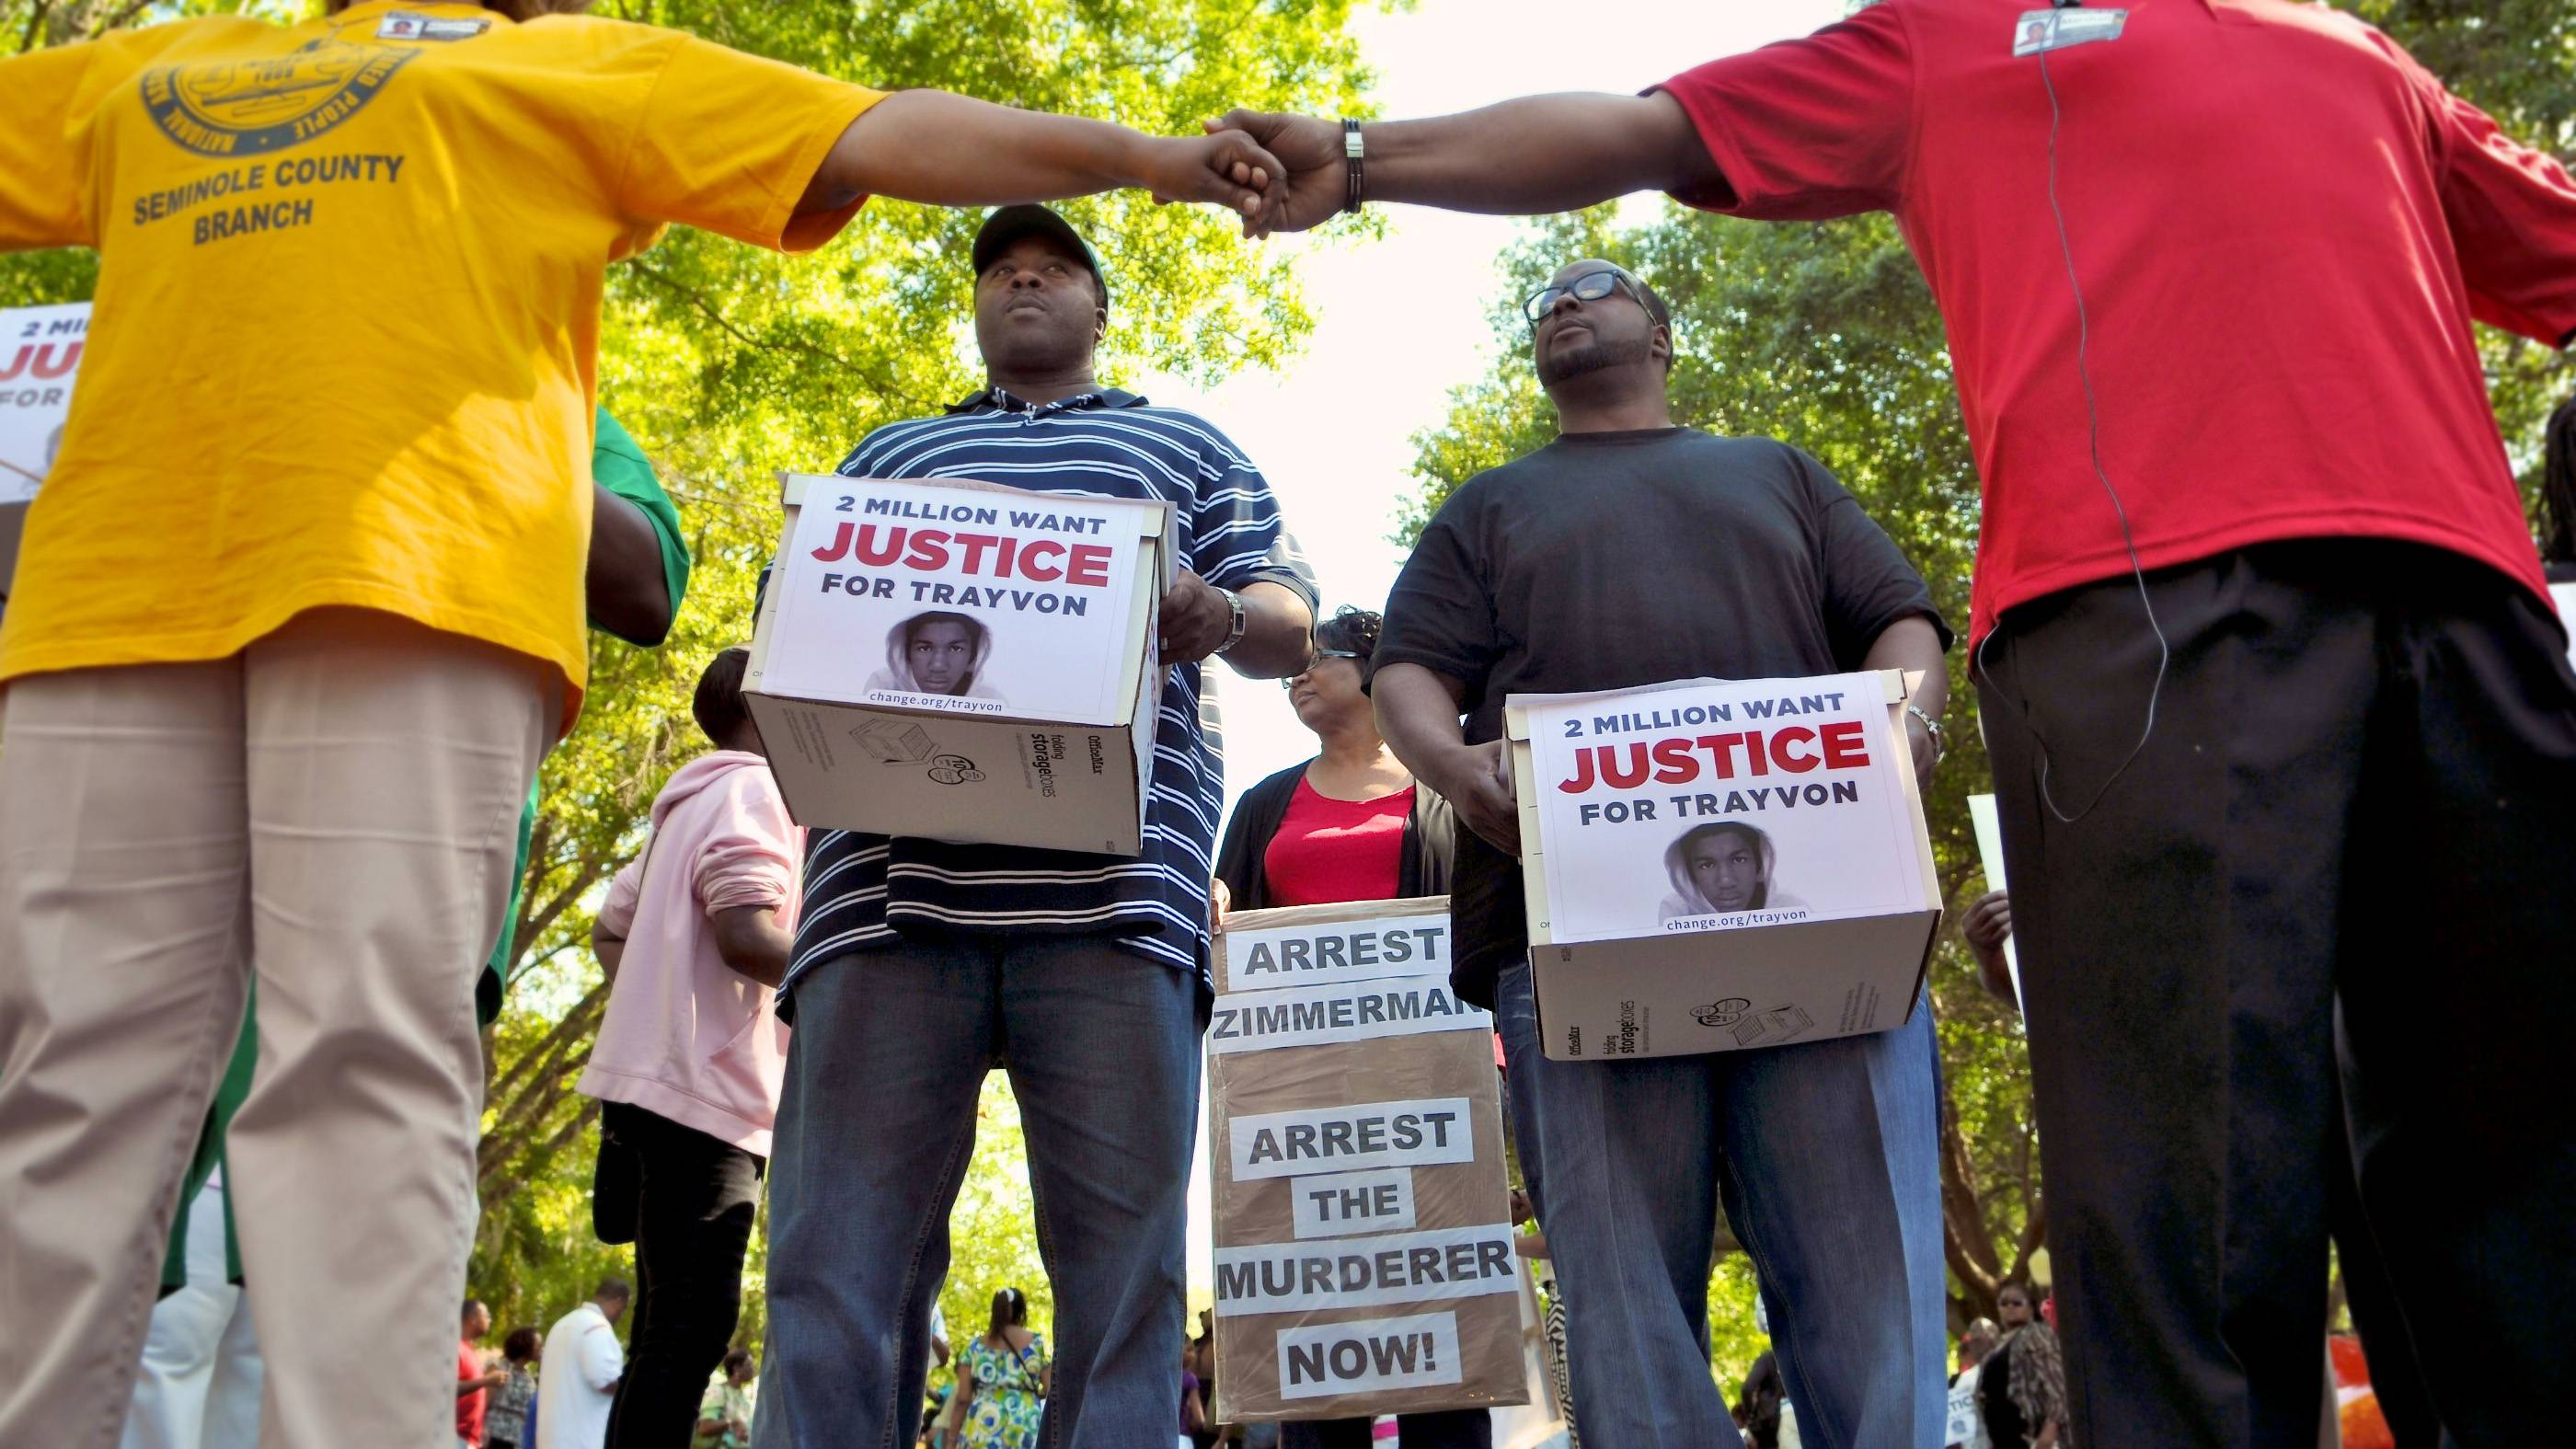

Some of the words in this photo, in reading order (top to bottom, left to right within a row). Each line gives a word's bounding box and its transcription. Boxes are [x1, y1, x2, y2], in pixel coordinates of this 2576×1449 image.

[294, 91, 360, 139] PEOPLE
[133, 165, 266, 226] SEMINOLE
[275, 155, 405, 188] COUNTY
[194, 199, 313, 246] BRANCH
[20, 321, 40, 338] 2
[836, 495, 854, 512] 2
[865, 498, 997, 525] MILLION
[1009, 511, 1106, 535] WANT
[811, 523, 1112, 588] JUSTICE
[821, 573, 896, 599] FOR
[910, 581, 1087, 616] TRAYVON
[869, 692, 1003, 713] change.org/trayvon
[1564, 719, 1583, 738] 2
[1593, 704, 1732, 735] MILLION
[1742, 693, 1845, 720] WANT
[1052, 734, 1064, 760] folding
[1088, 735, 1104, 775] OfficeMax
[1558, 720, 1870, 794] JUSTICE
[1580, 799, 1656, 826] FOR
[1670, 781, 1858, 818] TRAYVON
[1667, 908, 1807, 932] change.org/trayvon
[1244, 927, 1444, 975] ARREST
[1248, 1112, 1455, 1165] ARREST
[1309, 1184, 1400, 1222] THE
[1216, 1239, 1513, 1301] MURDERER
[1288, 1332, 1436, 1386] NOW!
